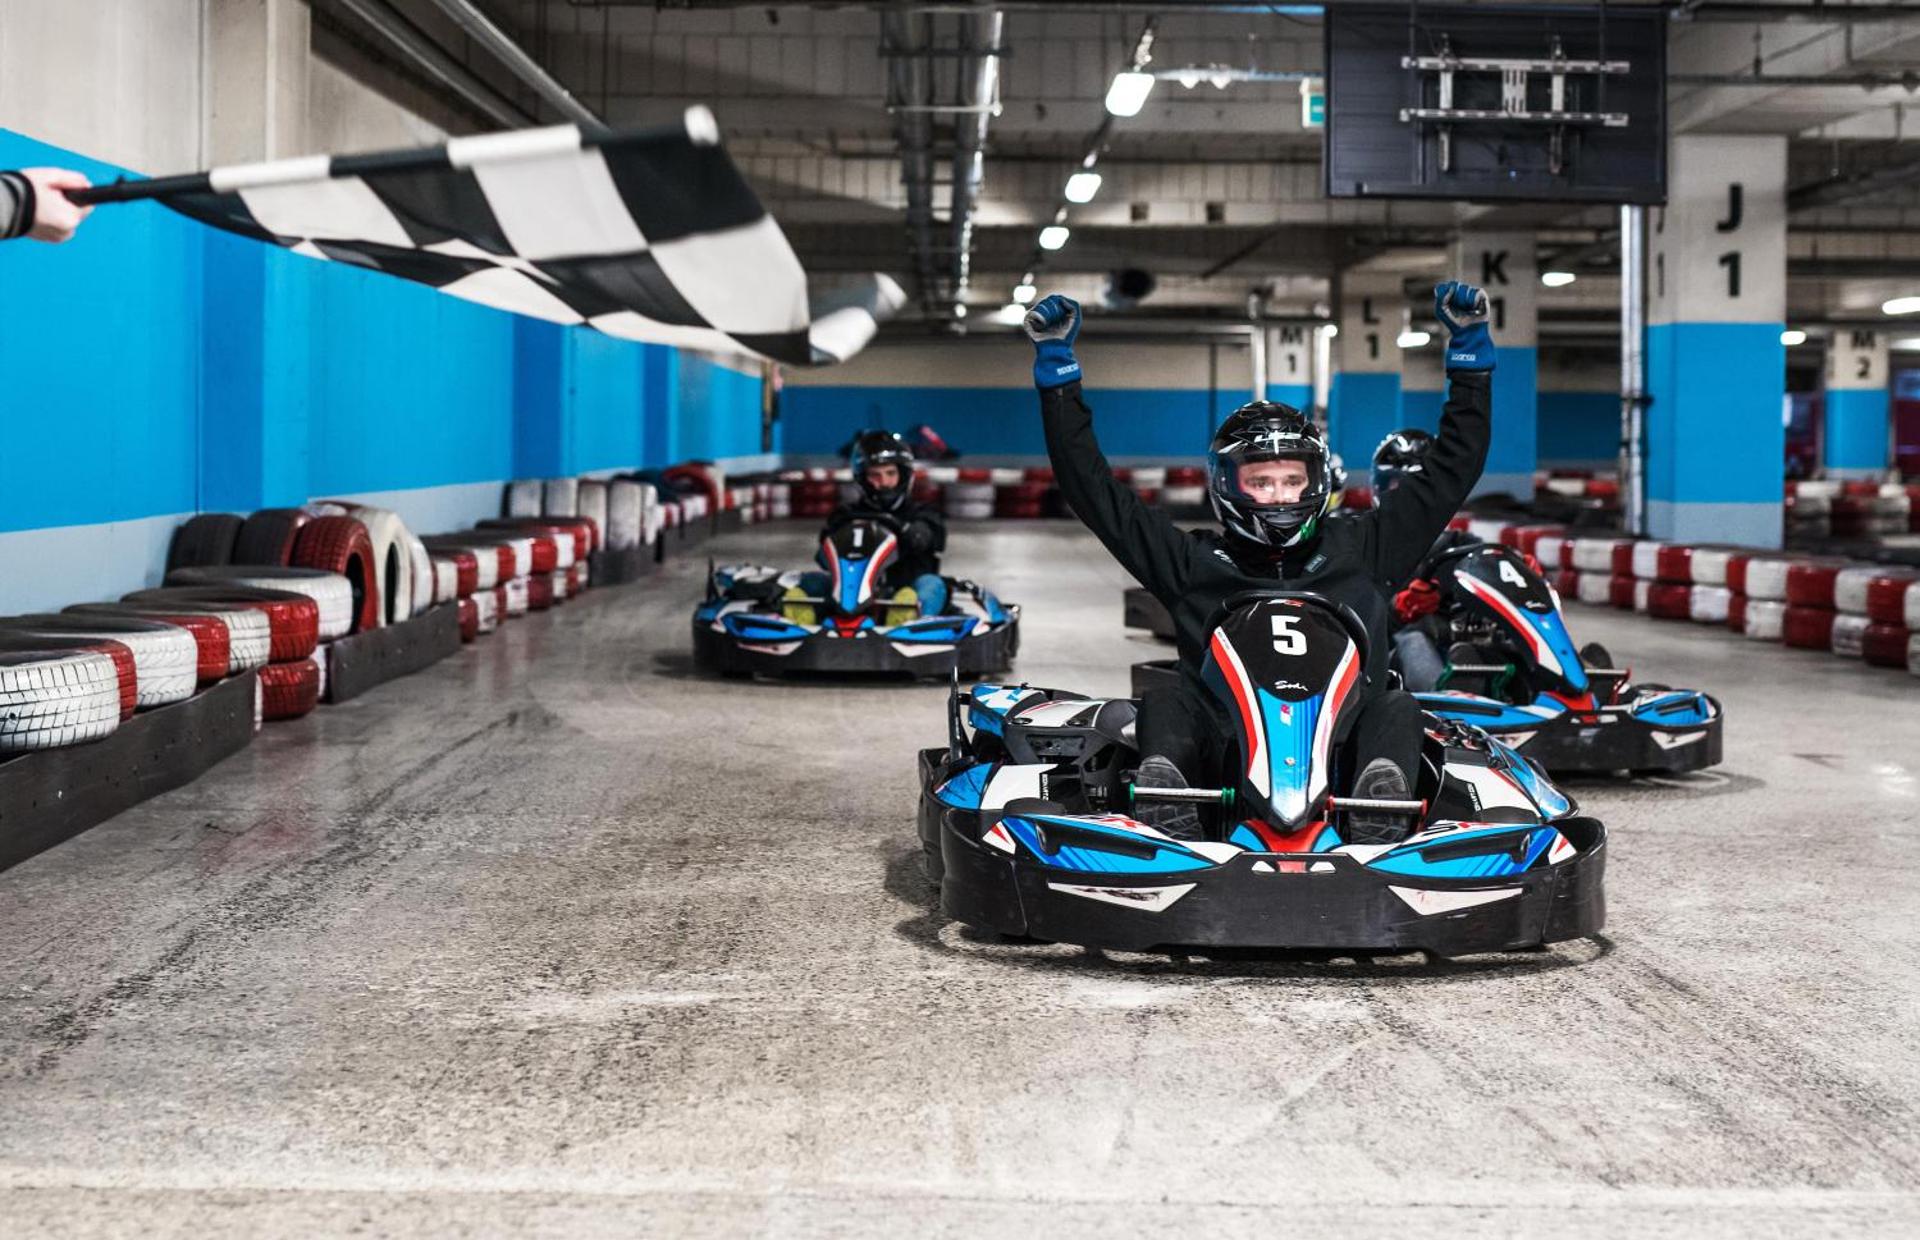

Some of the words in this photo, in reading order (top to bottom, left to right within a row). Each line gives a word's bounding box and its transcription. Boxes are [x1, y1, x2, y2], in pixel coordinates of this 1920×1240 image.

[1716, 183, 1742, 233] J
[1482, 252, 1509, 285] K
[1719, 251, 1741, 297] 1
[1363, 296, 1380, 325] L
[1489, 297, 1505, 329] 1
[1366, 334, 1378, 359] 1
[1288, 354, 1296, 373] 1
[1857, 356, 1871, 379] 2
[853, 528, 864, 547] 1
[1499, 560, 1528, 588] 4
[1271, 615, 1308, 656] 5
